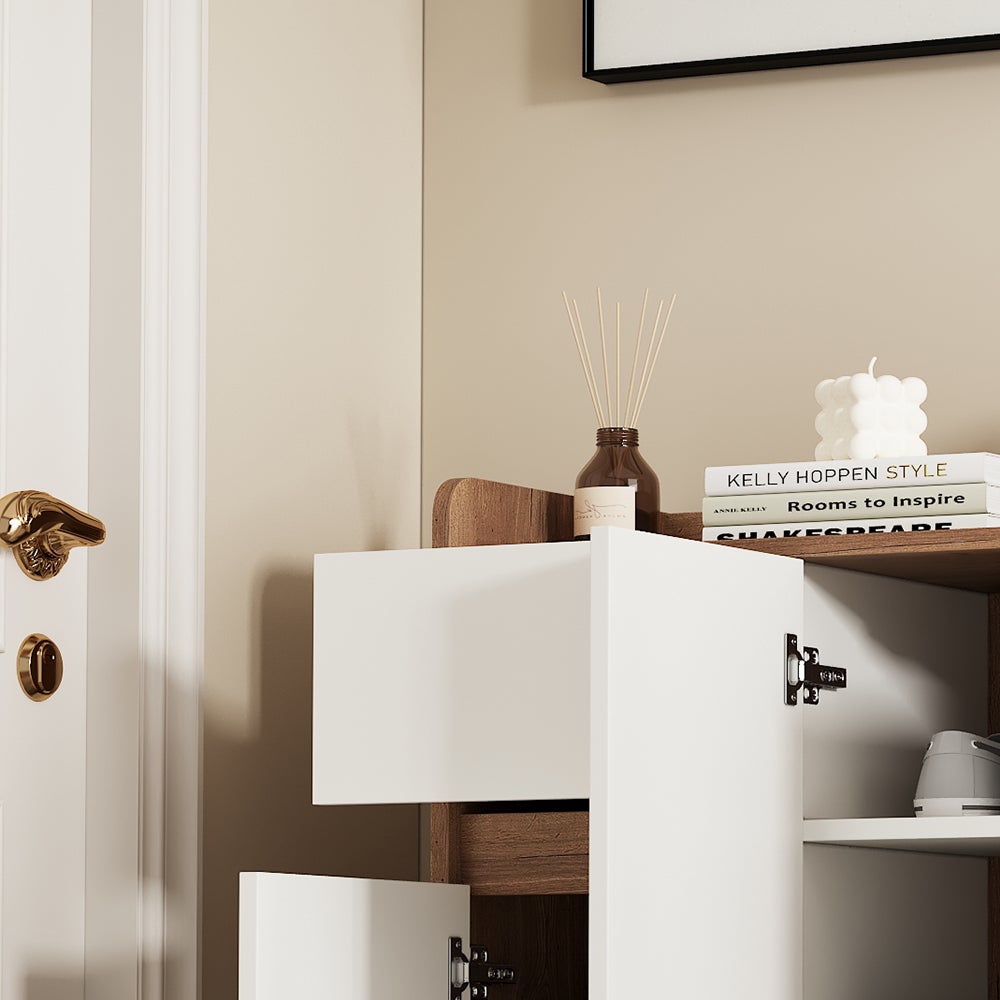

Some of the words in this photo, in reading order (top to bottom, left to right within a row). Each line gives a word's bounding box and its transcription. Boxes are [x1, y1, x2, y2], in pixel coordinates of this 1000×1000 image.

[728, 471, 789, 487] KELLY
[796, 467, 878, 484] HOPPEN
[886, 462, 948, 480] STYLE
[787, 500, 857, 512] Rooms
[864, 498, 886, 508] to
[893, 493, 966, 509] Inspire
